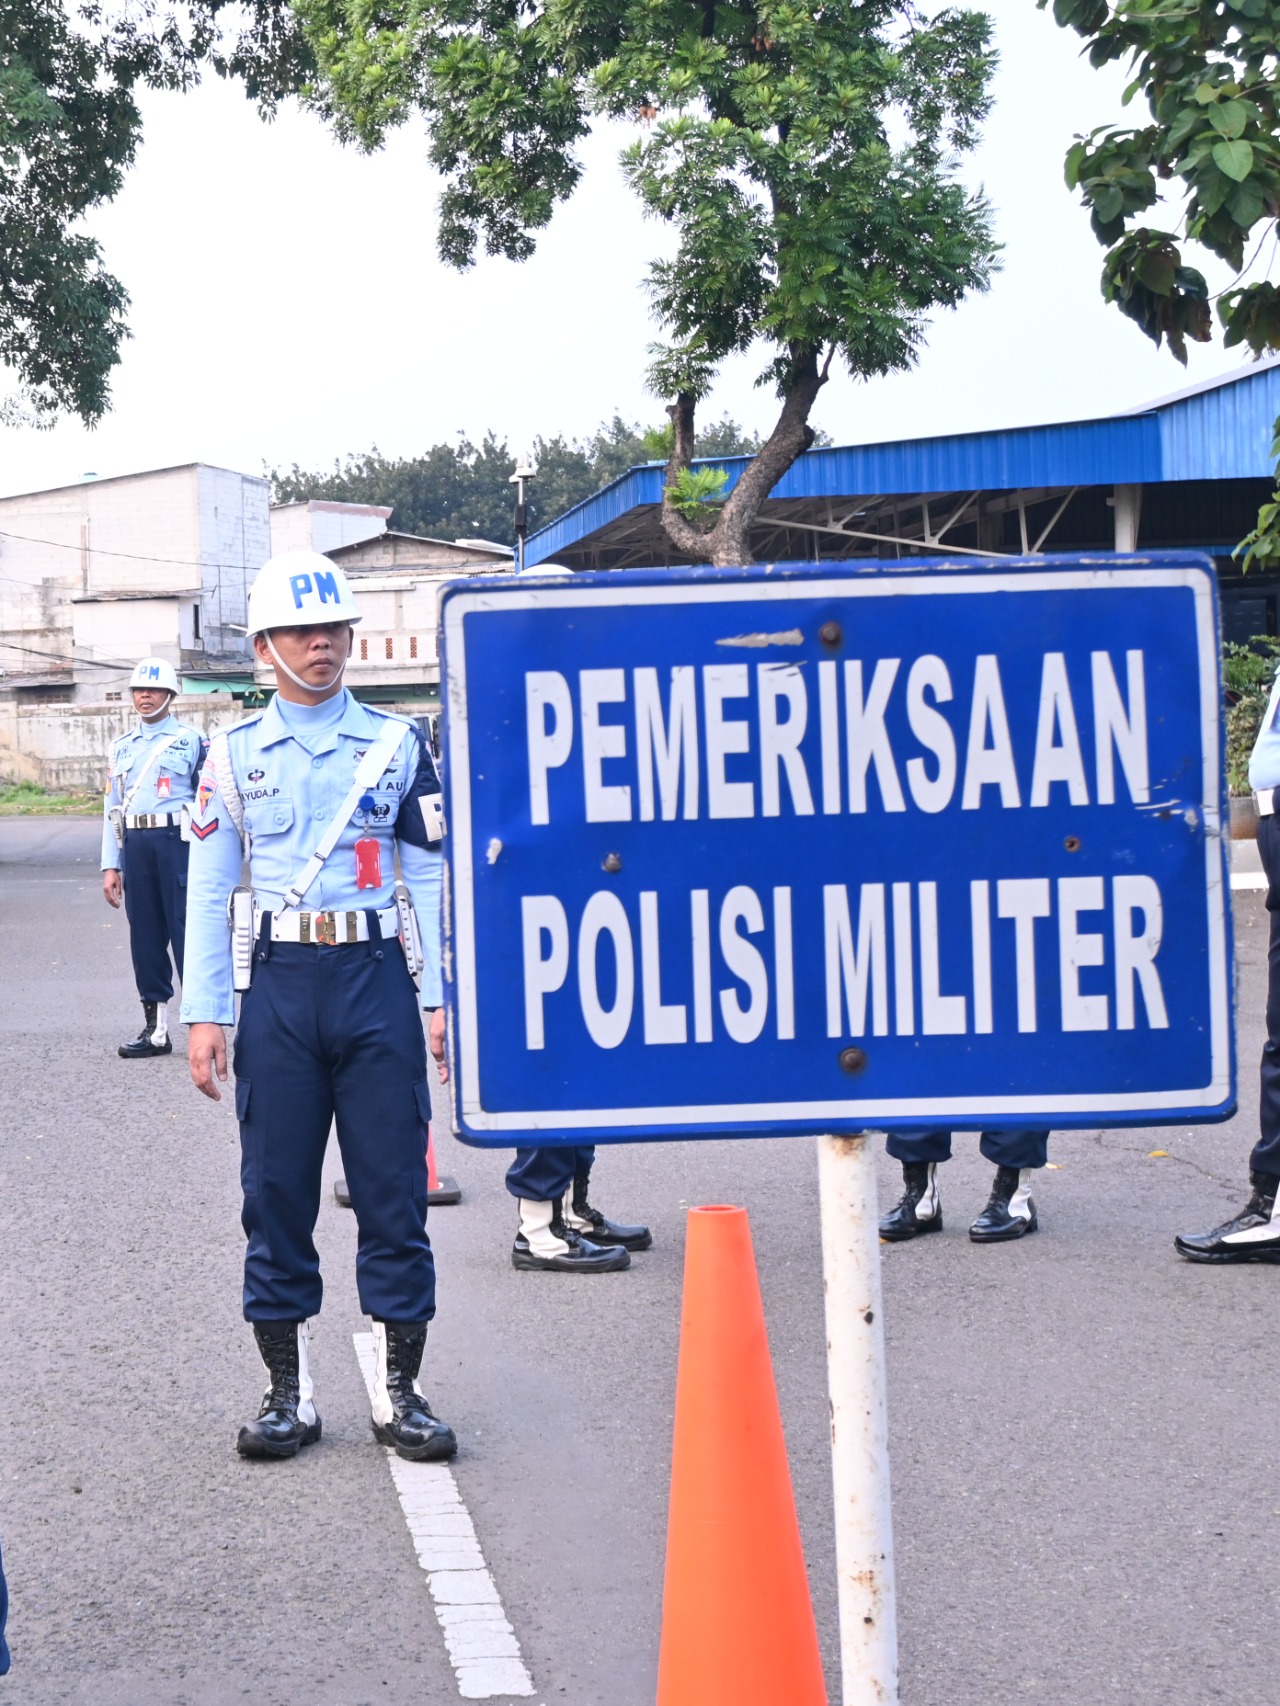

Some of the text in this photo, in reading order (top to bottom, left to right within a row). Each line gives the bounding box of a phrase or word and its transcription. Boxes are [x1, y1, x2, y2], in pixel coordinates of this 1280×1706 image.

[289, 571, 341, 609] PM
[140, 666, 160, 680] PM
[525, 650, 1150, 825] PEMERIKSAAN
[385, 781, 404, 791] AU
[521, 875, 1169, 1050] POLISI MILITER
